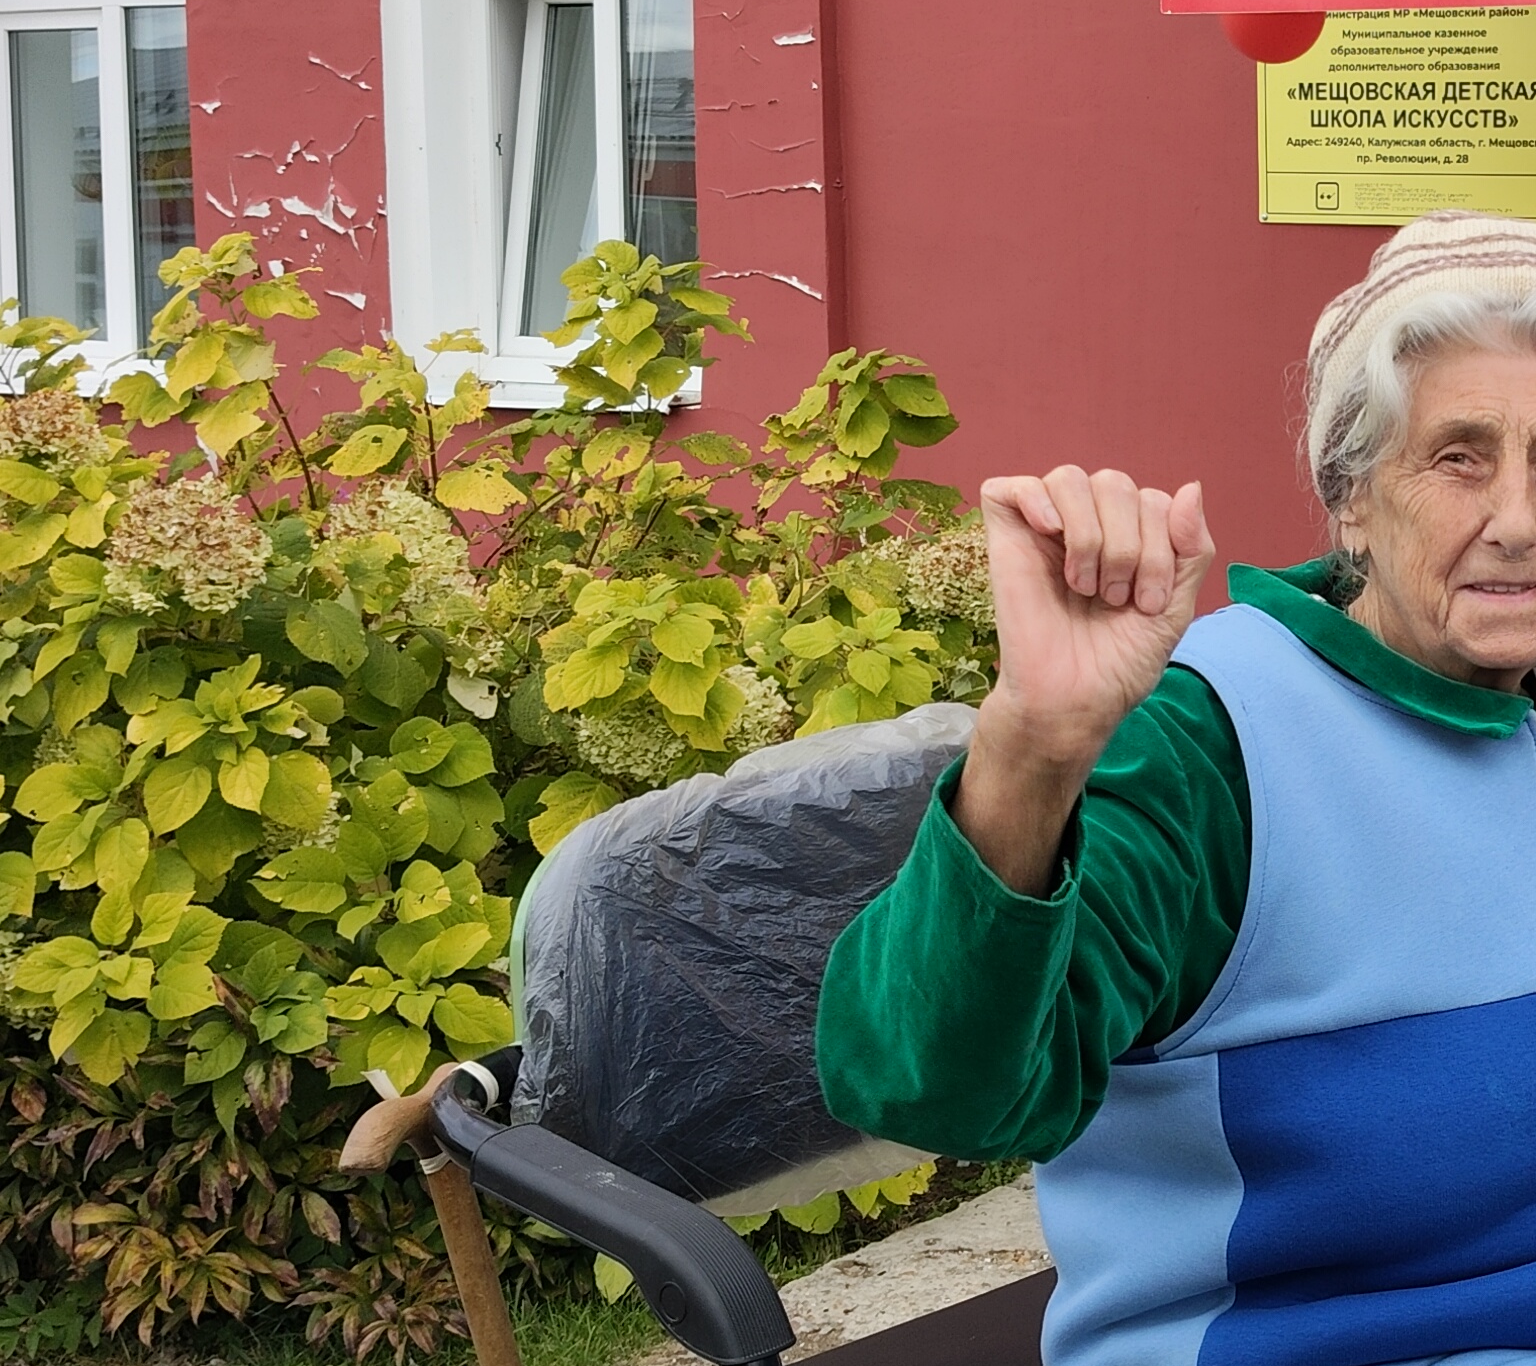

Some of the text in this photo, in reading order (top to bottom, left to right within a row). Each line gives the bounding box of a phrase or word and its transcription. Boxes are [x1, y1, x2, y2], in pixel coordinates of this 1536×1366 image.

[1325, 6, 1530, 21] инистрация МР «Мещовский район»
[1342, 28, 1488, 41] Муниципальное казенное
[1330, 45, 1499, 57] образовательное учреждение
[1328, 60, 1501, 73] дополнительного образования
[1287, 82, 1436, 104] «МЕЩОВСКАЯ
[1310, 109, 1519, 128] ШКОЛА ИСКУССТВ»
[1286, 137, 1323, 149] Адрес:
[1325, 137, 1365, 149] 249240,
[1367, 137, 1426, 150] Калужская
[1429, 137, 1475, 149] область,
[1478, 140, 1486, 148] г.
[1356, 153, 1469, 166] пр. Революции, д. 28
